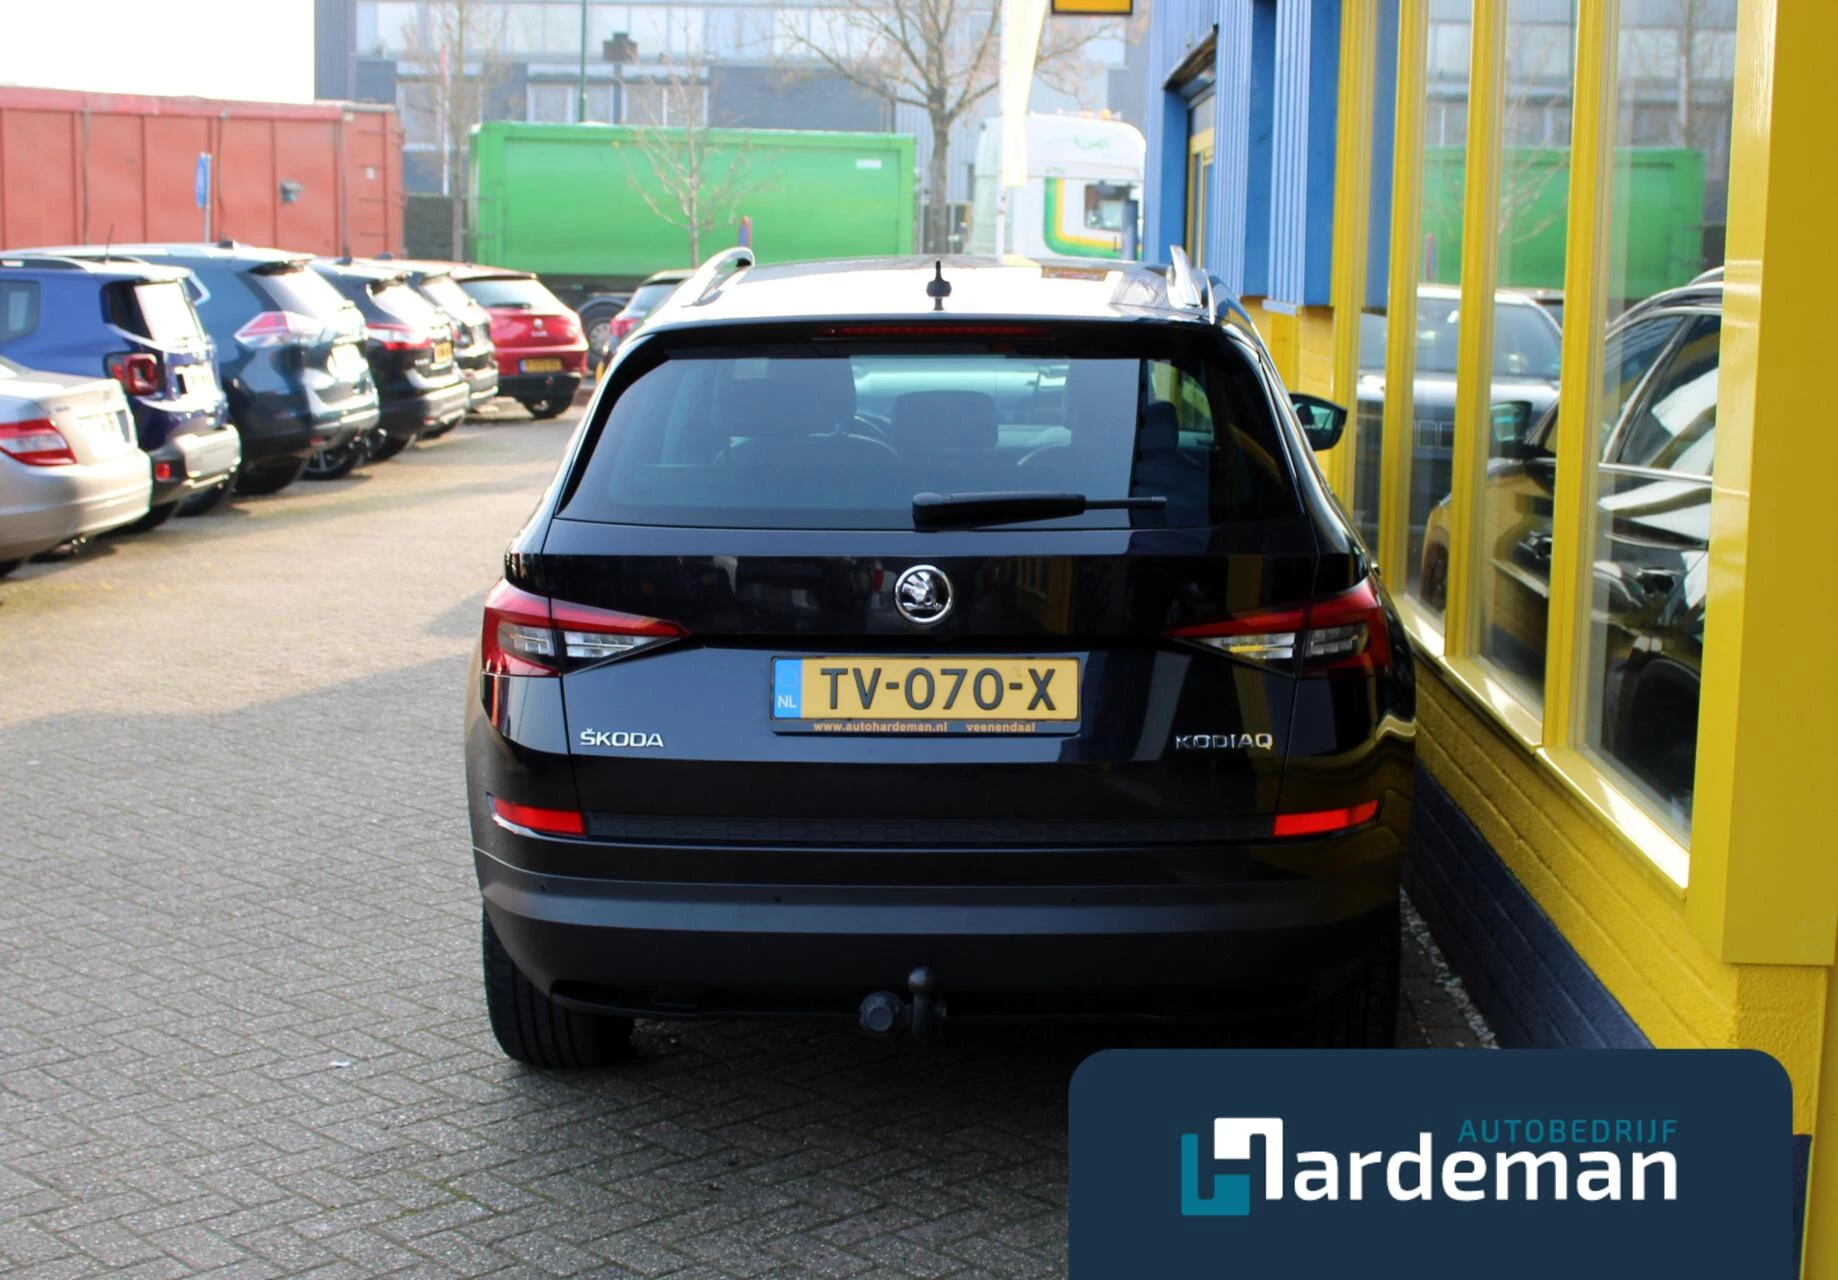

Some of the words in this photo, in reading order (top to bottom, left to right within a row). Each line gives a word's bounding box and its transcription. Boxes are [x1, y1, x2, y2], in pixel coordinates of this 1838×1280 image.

[820, 667, 1056, 711] TV-070-X
[777, 695, 797, 709] NL
[813, 721, 948, 733] www.autohardeman.nl
[965, 721, 1036, 733] veenendaal
[580, 727, 664, 747] ŠKODA
[1175, 733, 1273, 750] KODIAQ
